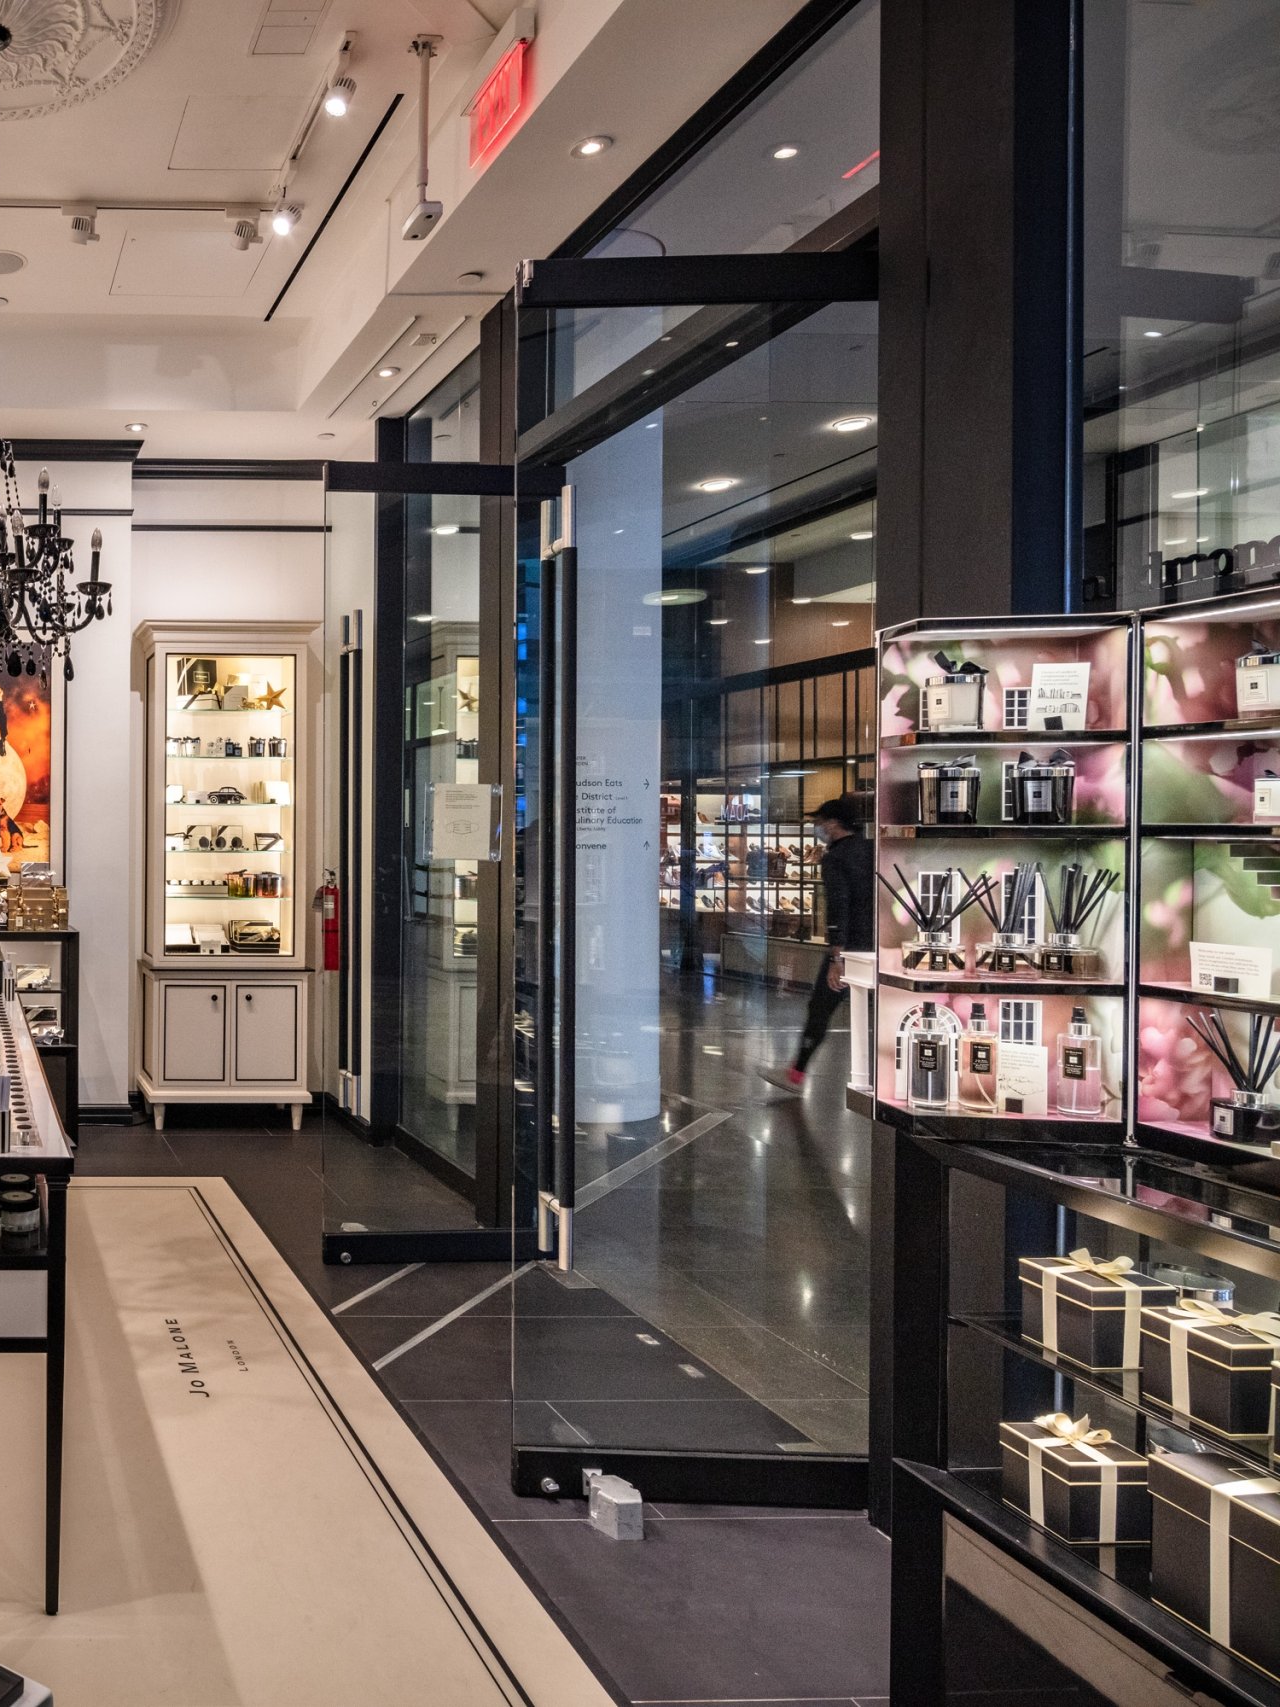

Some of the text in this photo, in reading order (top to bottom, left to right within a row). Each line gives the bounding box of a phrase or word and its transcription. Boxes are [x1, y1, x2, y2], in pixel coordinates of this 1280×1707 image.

[608, 806, 616, 814] of
[576, 816, 642, 826] ulinary Education
[165, 1319, 210, 1397] JO MALONE
[227, 1340, 248, 1372] LONDON
